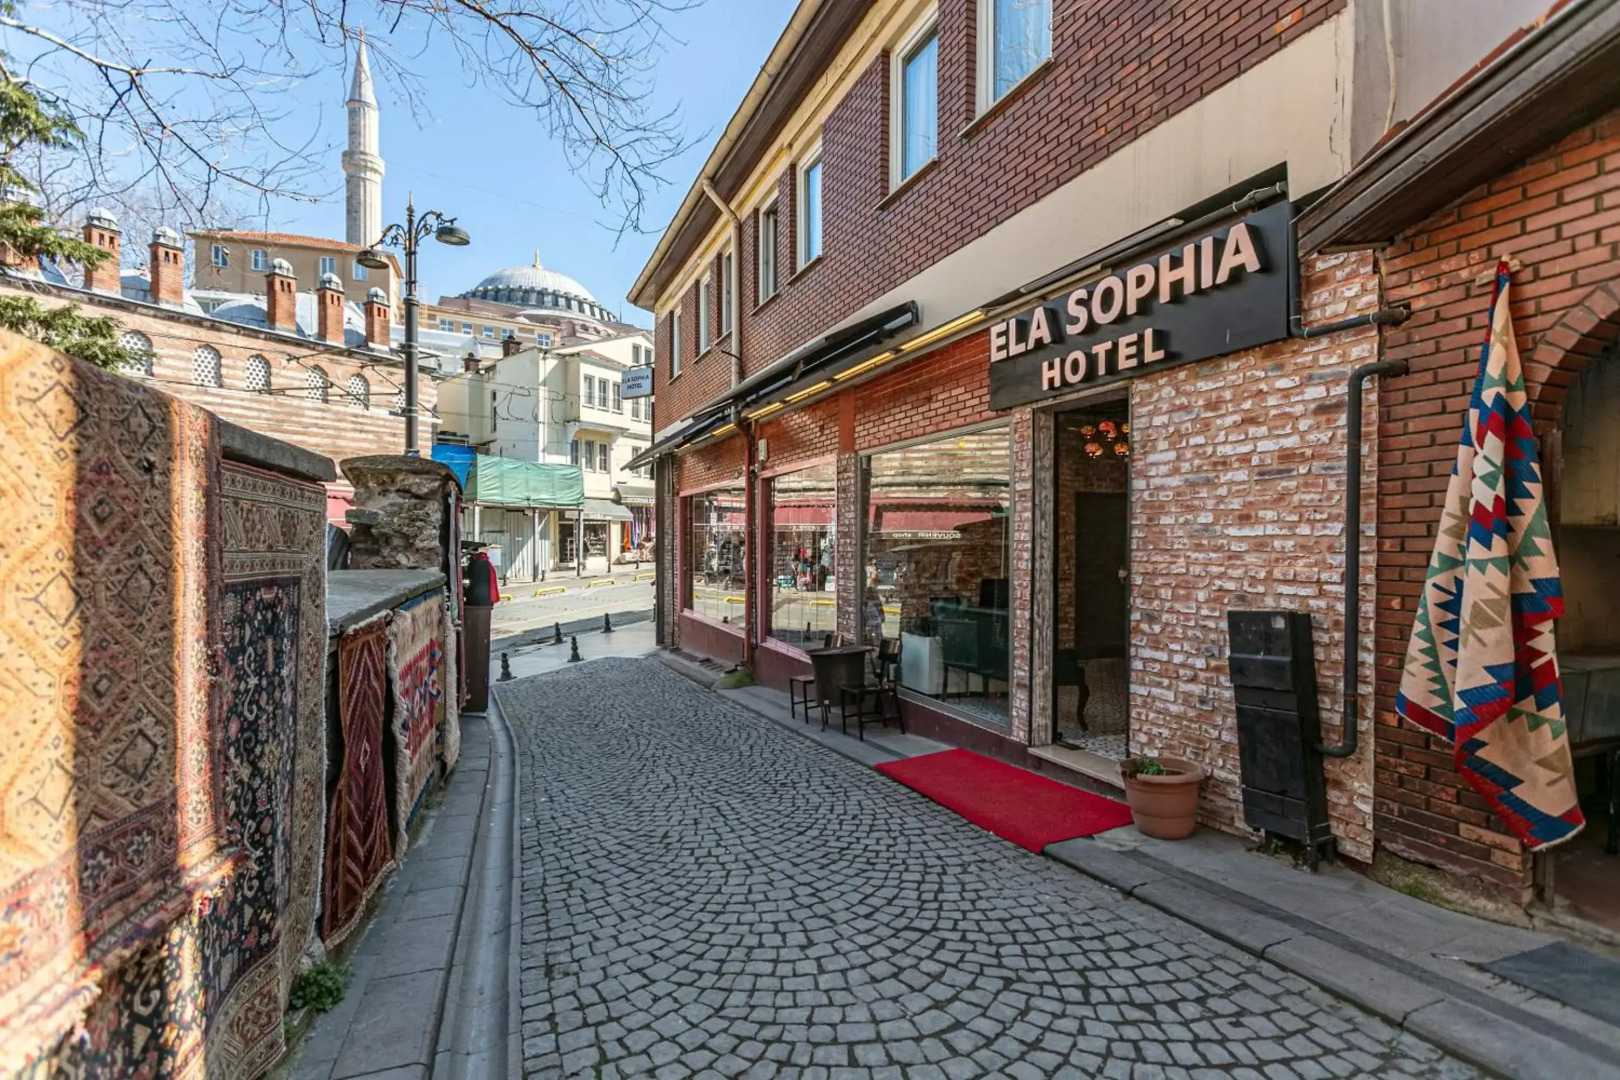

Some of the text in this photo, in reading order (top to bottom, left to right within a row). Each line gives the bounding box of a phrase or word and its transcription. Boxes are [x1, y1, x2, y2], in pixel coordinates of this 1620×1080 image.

[990, 222, 1261, 363] ELA SOPHIA
[1042, 328, 1165, 391] HOTEL
